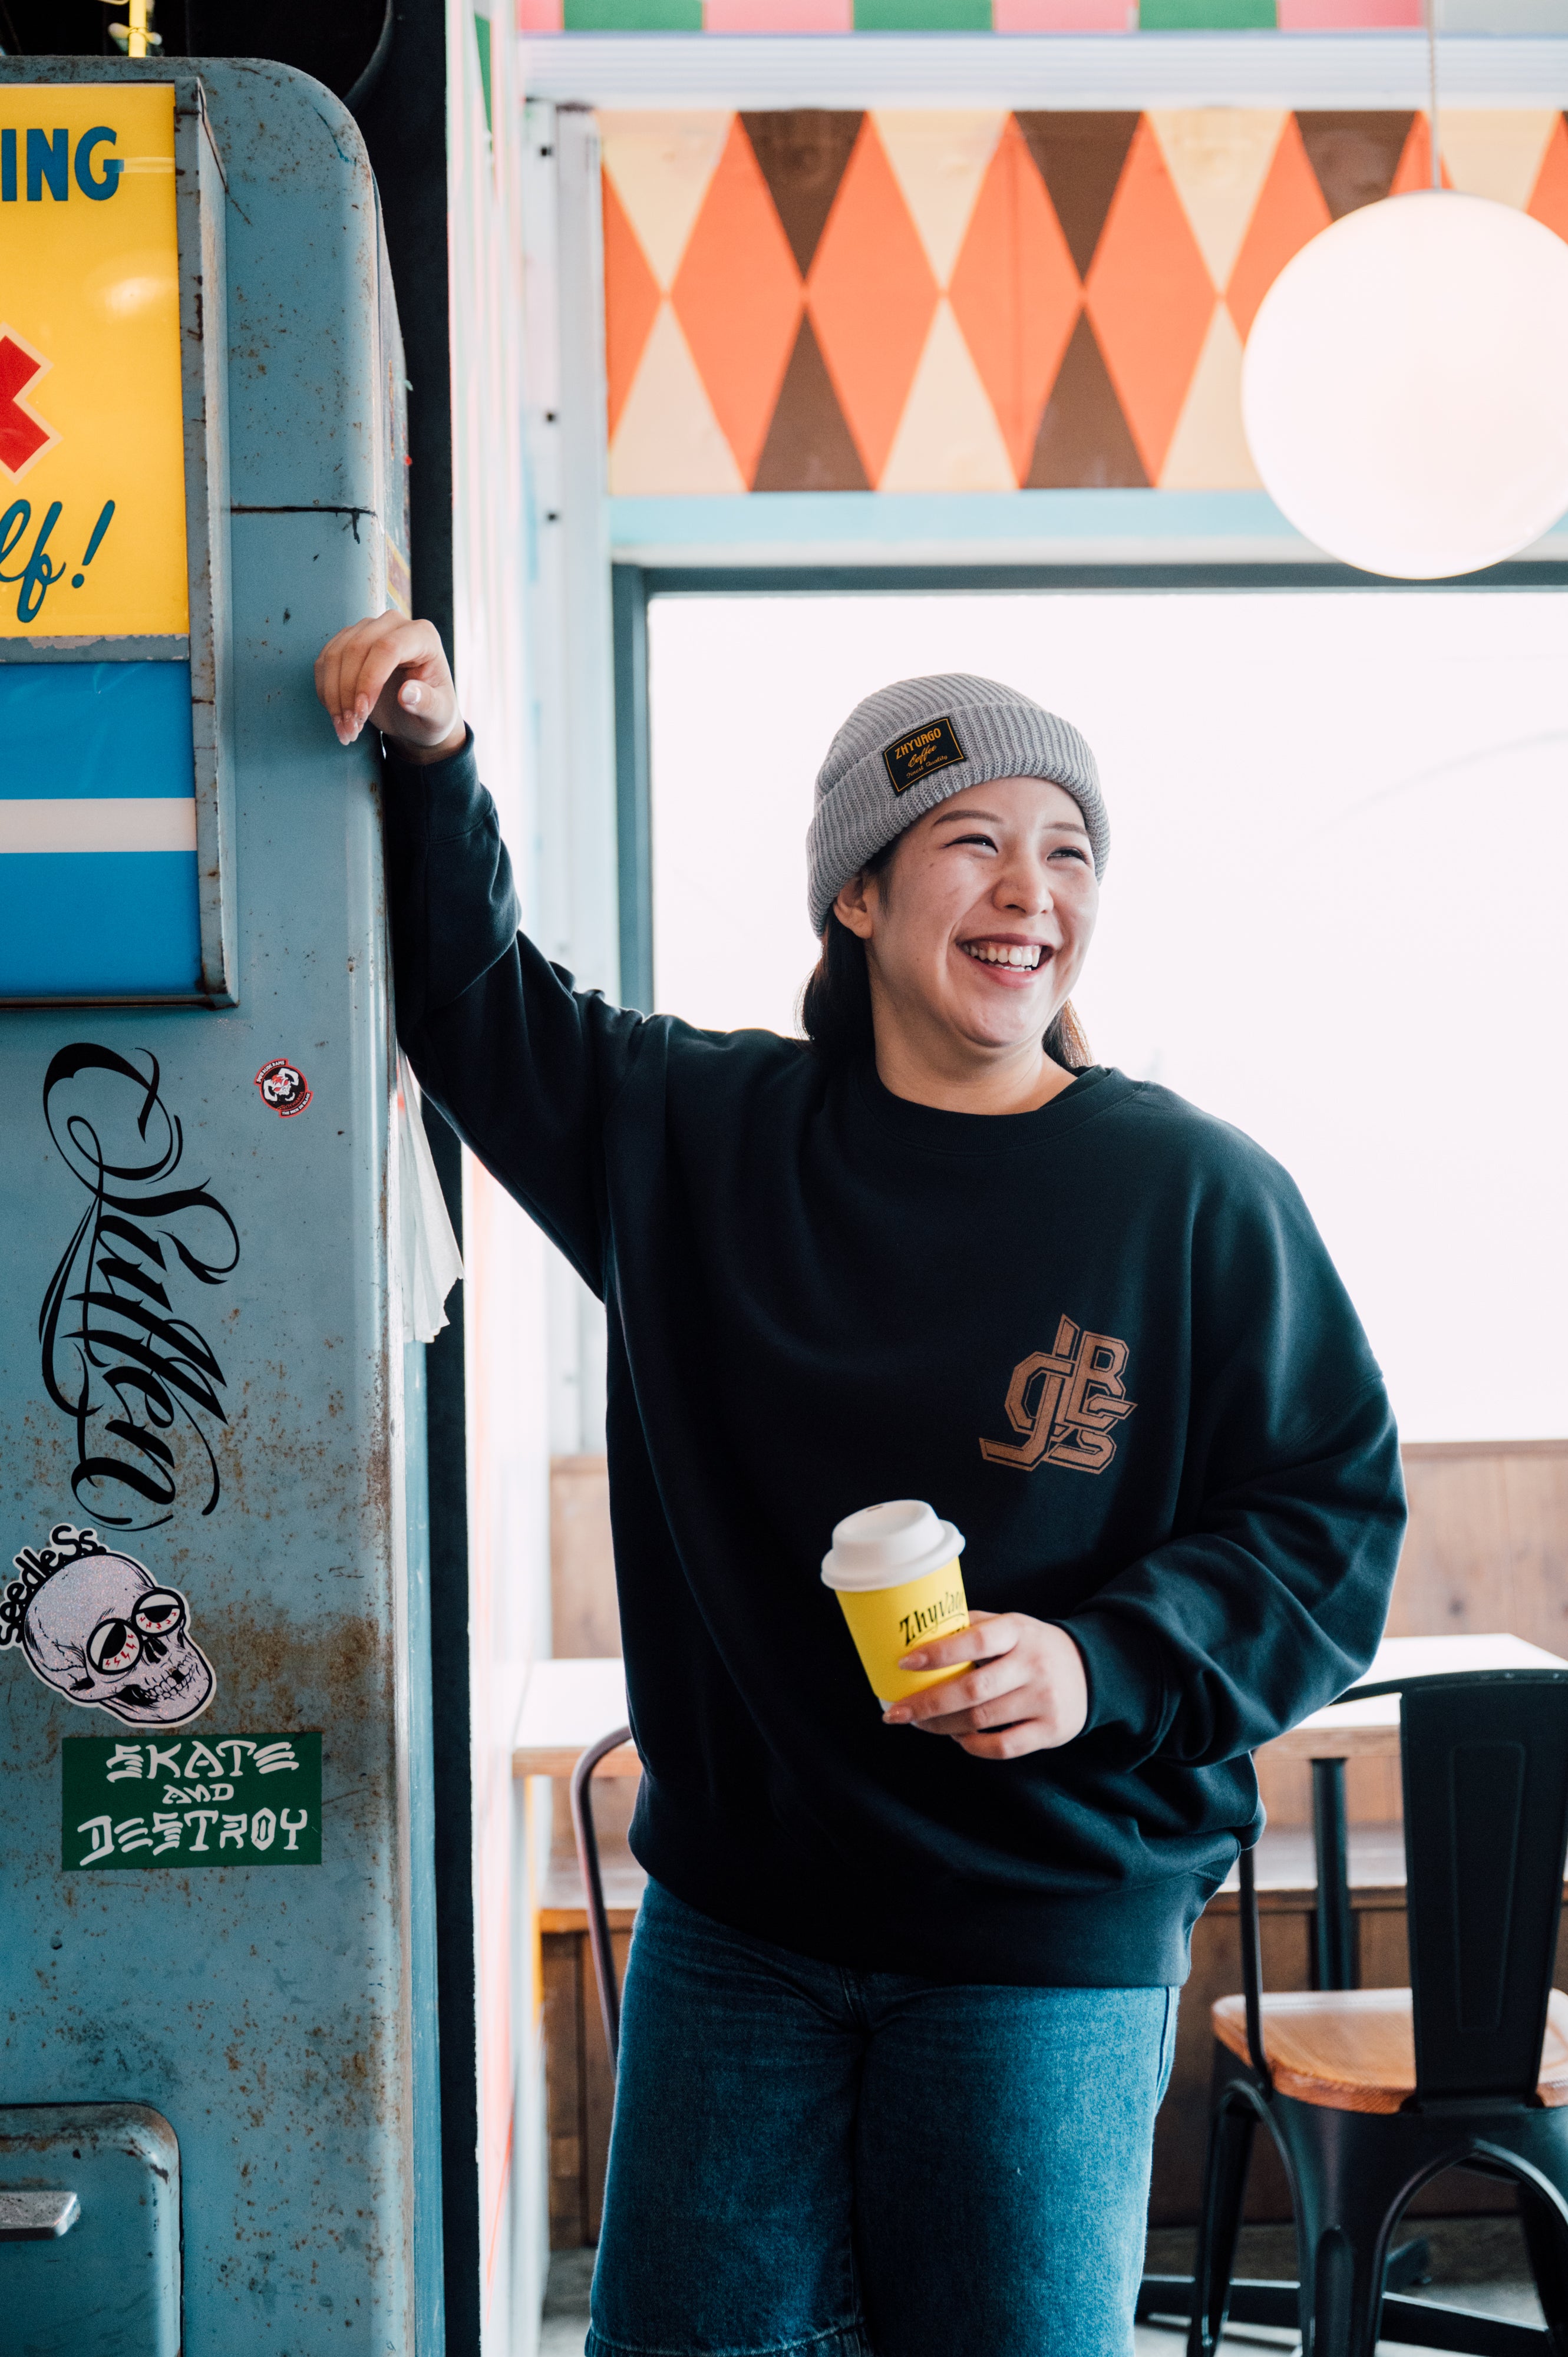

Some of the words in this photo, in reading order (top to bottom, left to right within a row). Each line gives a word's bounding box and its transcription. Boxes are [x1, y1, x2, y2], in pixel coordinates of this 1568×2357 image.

[1, 126, 124, 202] ING
[908, 744, 938, 768] Coffee
[926, 755, 948, 767] Quality
[302, 1093, 311, 1106] BLACK
[106, 1739, 299, 1783] SKATE
[162, 1783, 234, 1804] AND
[77, 1807, 308, 1866] DESTROY
